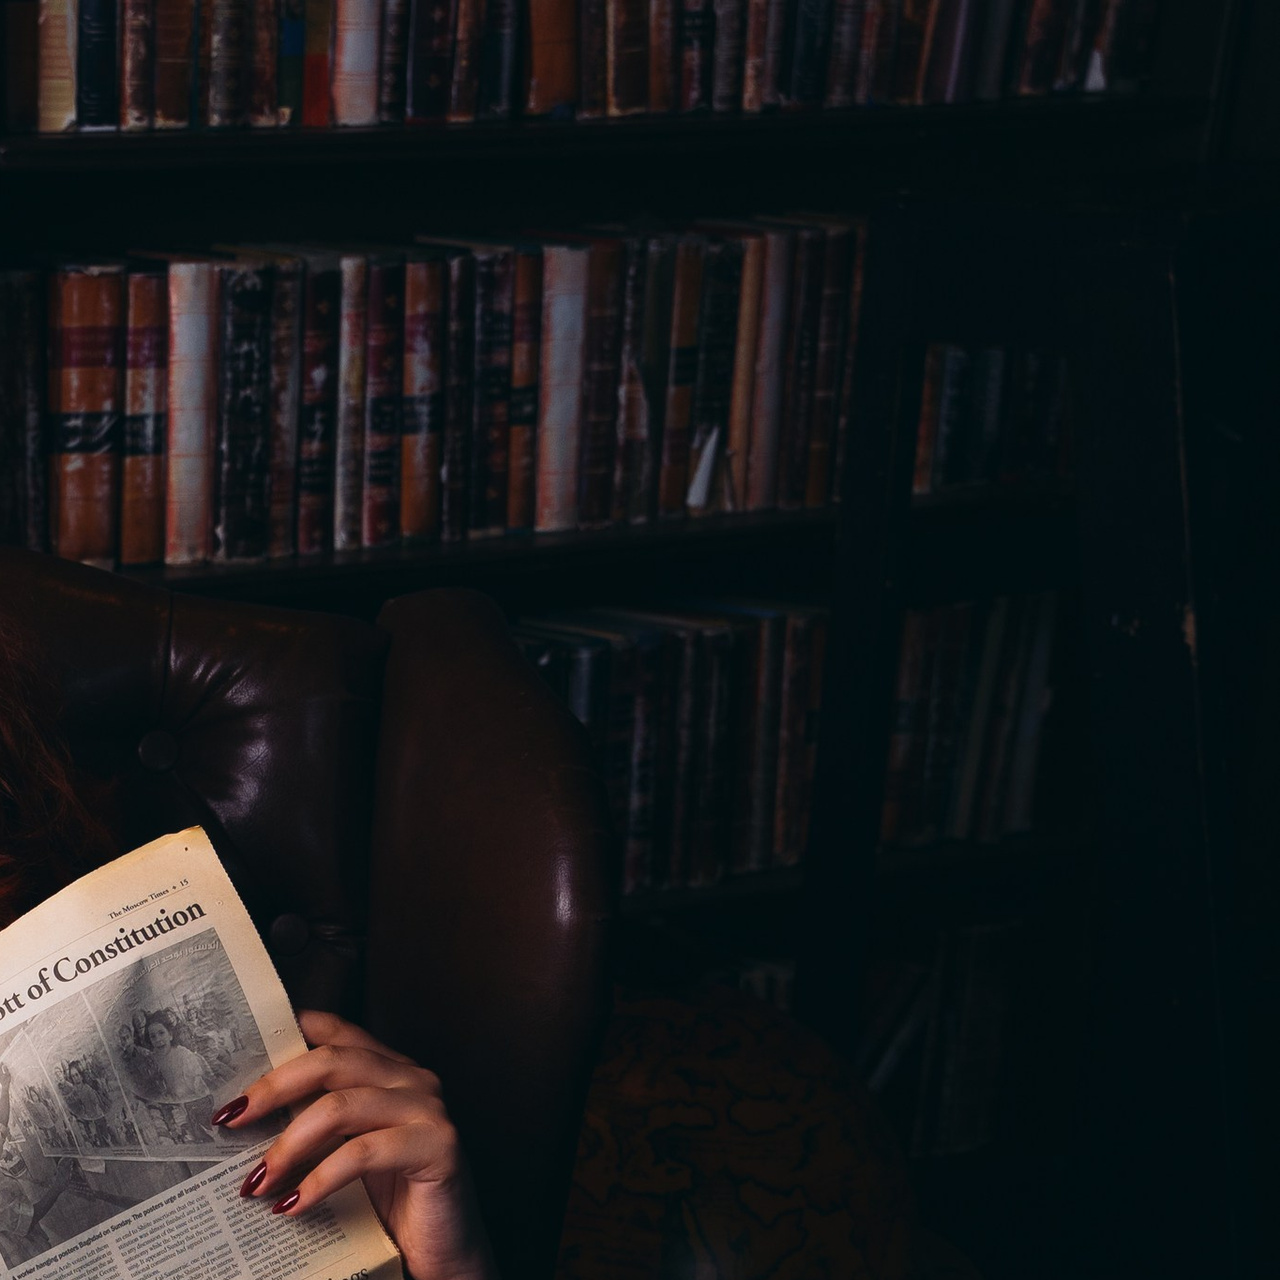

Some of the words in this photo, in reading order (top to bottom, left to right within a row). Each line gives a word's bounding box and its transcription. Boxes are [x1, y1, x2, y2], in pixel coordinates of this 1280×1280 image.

[108, 910, 123, 920] The
[121, 898, 149, 914] Moscow
[147, 888, 170, 901] Times
[178, 877, 189, 887] 15
[26, 966, 54, 1001] of
[52, 902, 207, 983] Constitution
[15, 1266, 36, 1280] worker
[34, 1254, 59, 1271] hanging
[57, 1244, 80, 1261] posters
[77, 1230, 104, 1249] Baghdad
[101, 1227, 112, 1237] on
[130, 1211, 144, 1221] The
[141, 1201, 165, 1217] posters
[162, 1194, 177, 1206] urge
[206, 1167, 229, 1184] support
[227, 1163, 239, 1173] the
